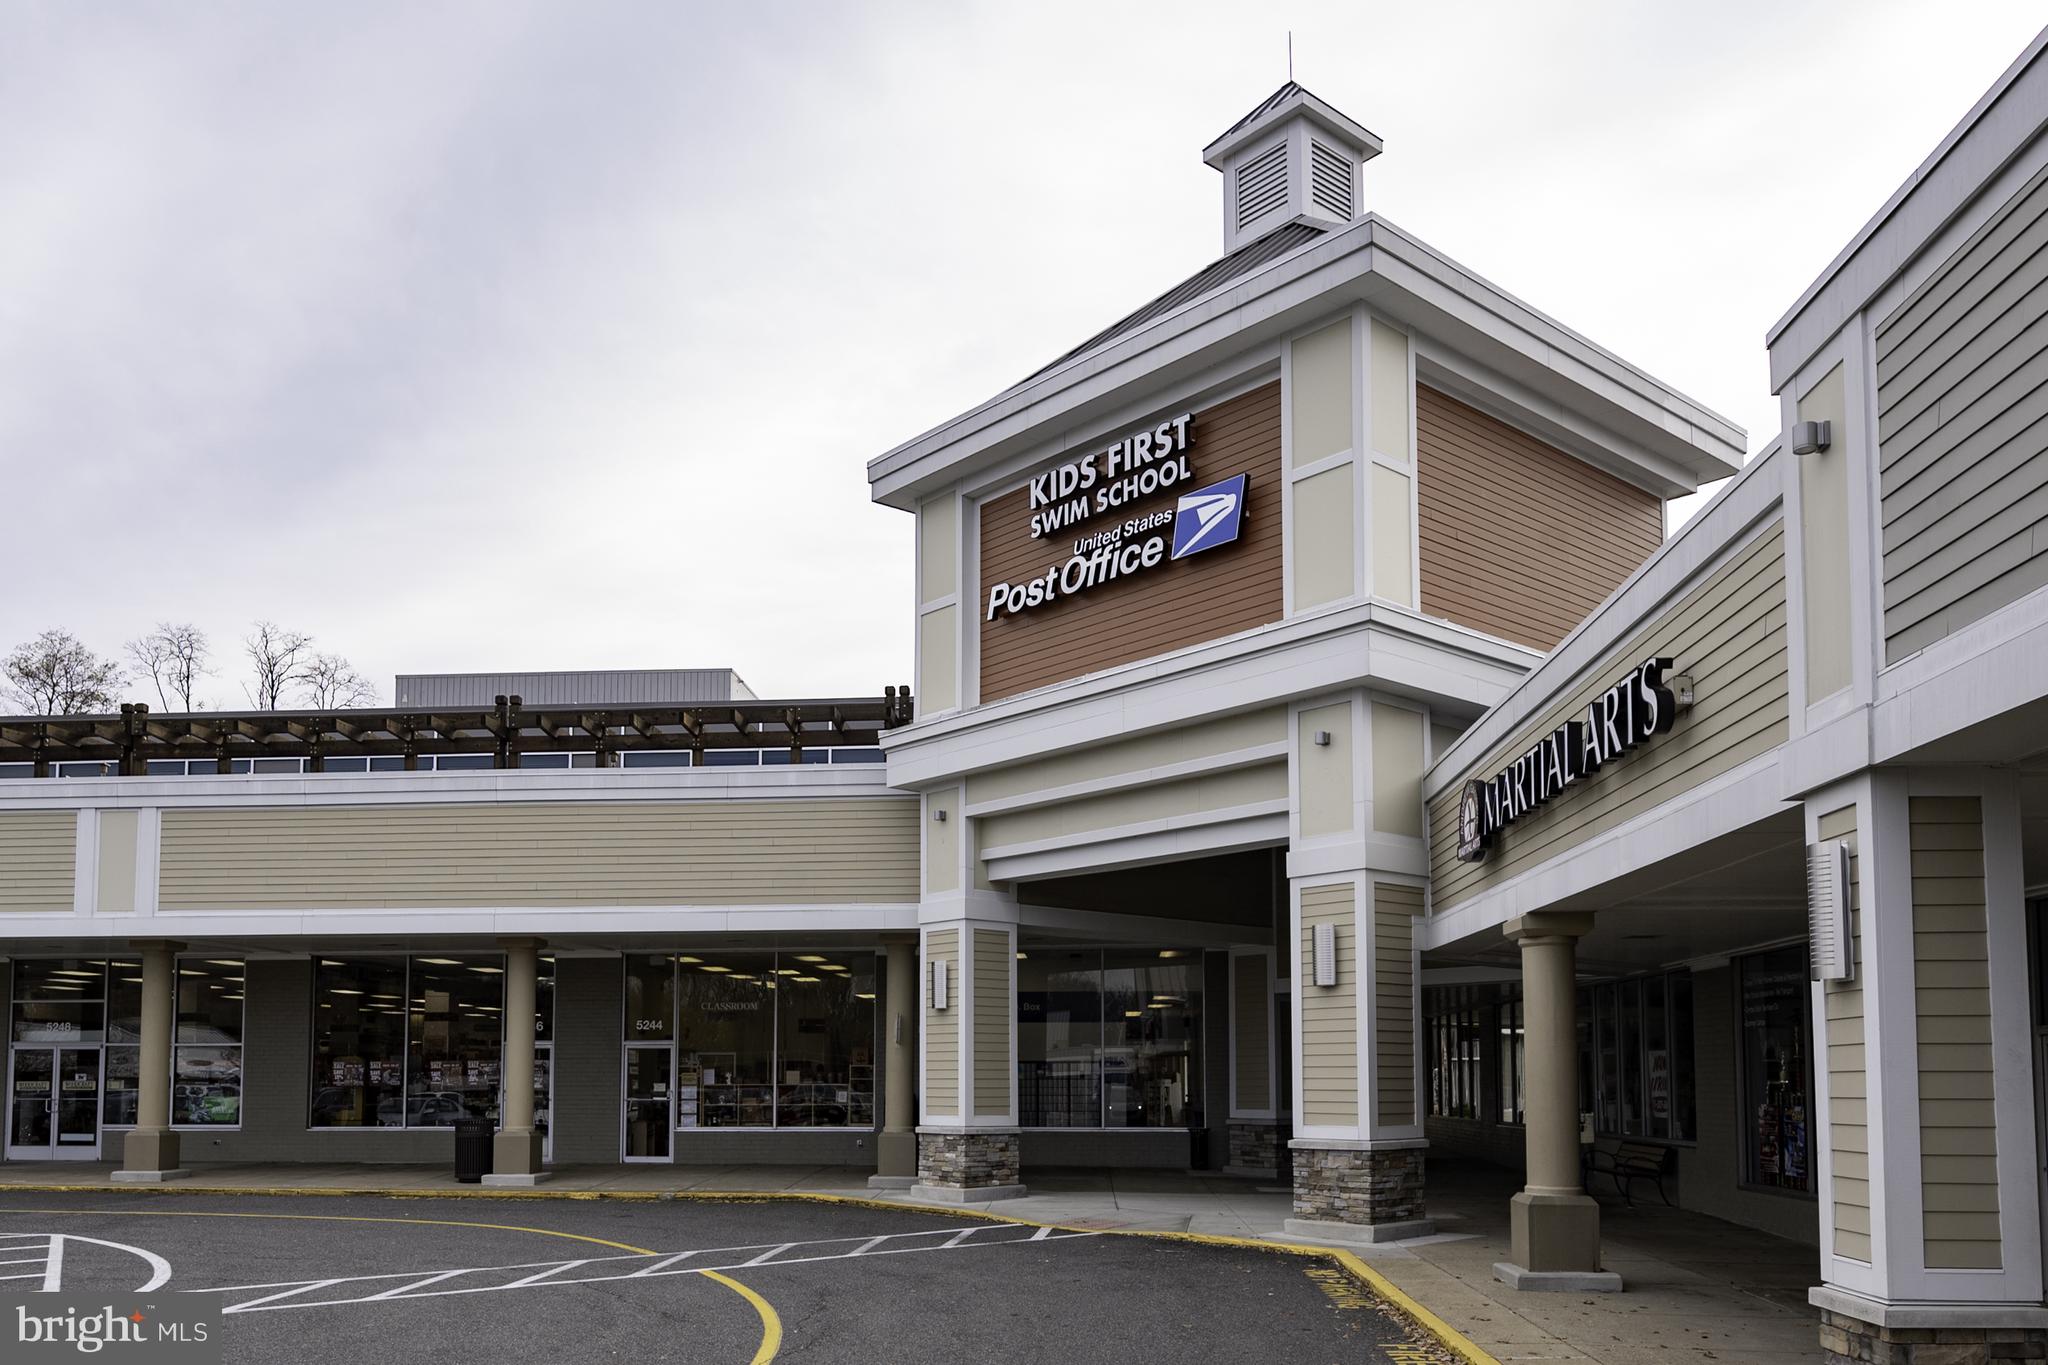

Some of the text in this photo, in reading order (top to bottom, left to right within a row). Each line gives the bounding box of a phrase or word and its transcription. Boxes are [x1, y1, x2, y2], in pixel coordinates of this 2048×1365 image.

[1029, 413, 1191, 510] KIDS FIRST
[1030, 456, 1191, 539] SWIM SCHOOL
[1073, 509, 1173, 555] United States
[986, 536, 1165, 621] Post Office
[1483, 658, 1660, 836] MARTIAL ARTS
[46, 1022, 72, 1033] 5248
[635, 1019, 663, 1031] 5244
[701, 1001, 759, 1011] CLASSROOM
